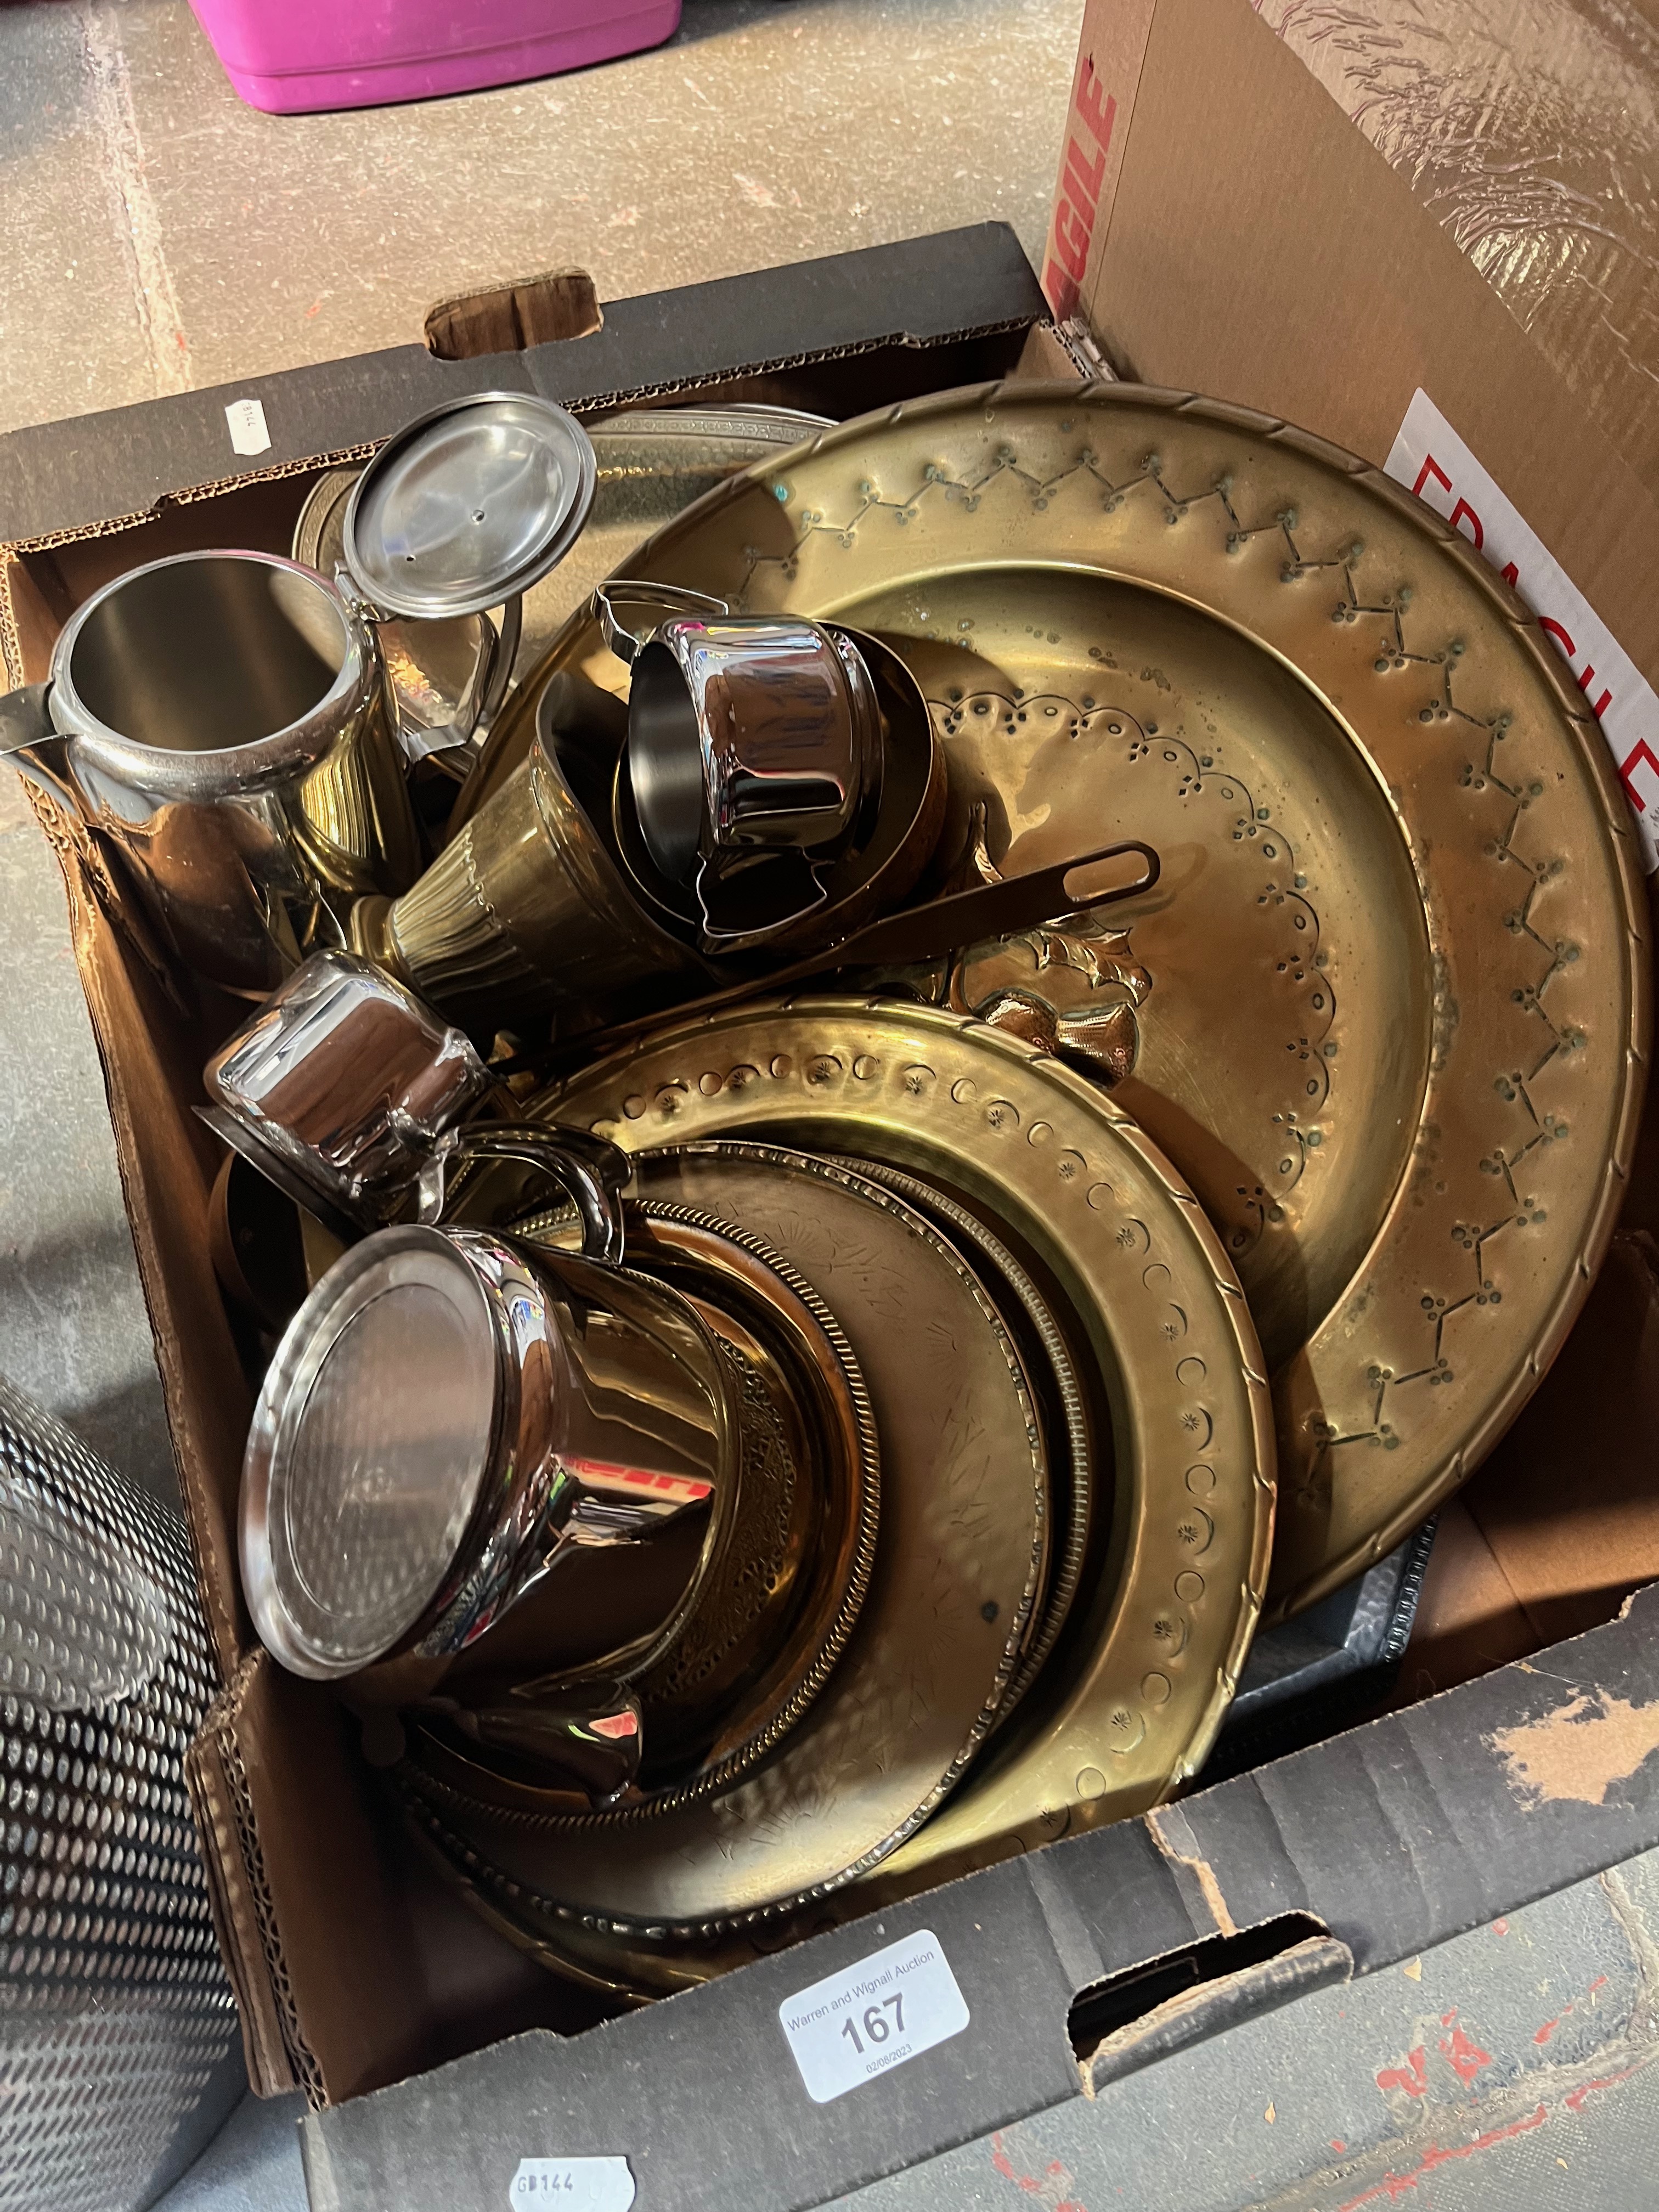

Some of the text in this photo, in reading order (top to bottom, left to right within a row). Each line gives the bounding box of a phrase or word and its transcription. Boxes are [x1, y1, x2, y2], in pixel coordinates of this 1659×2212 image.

[1047, 56, 1117, 324] AGILE
[787, 1950, 935, 2032] Warren and Wignall Auction
[841, 1991, 906, 2054] 167
